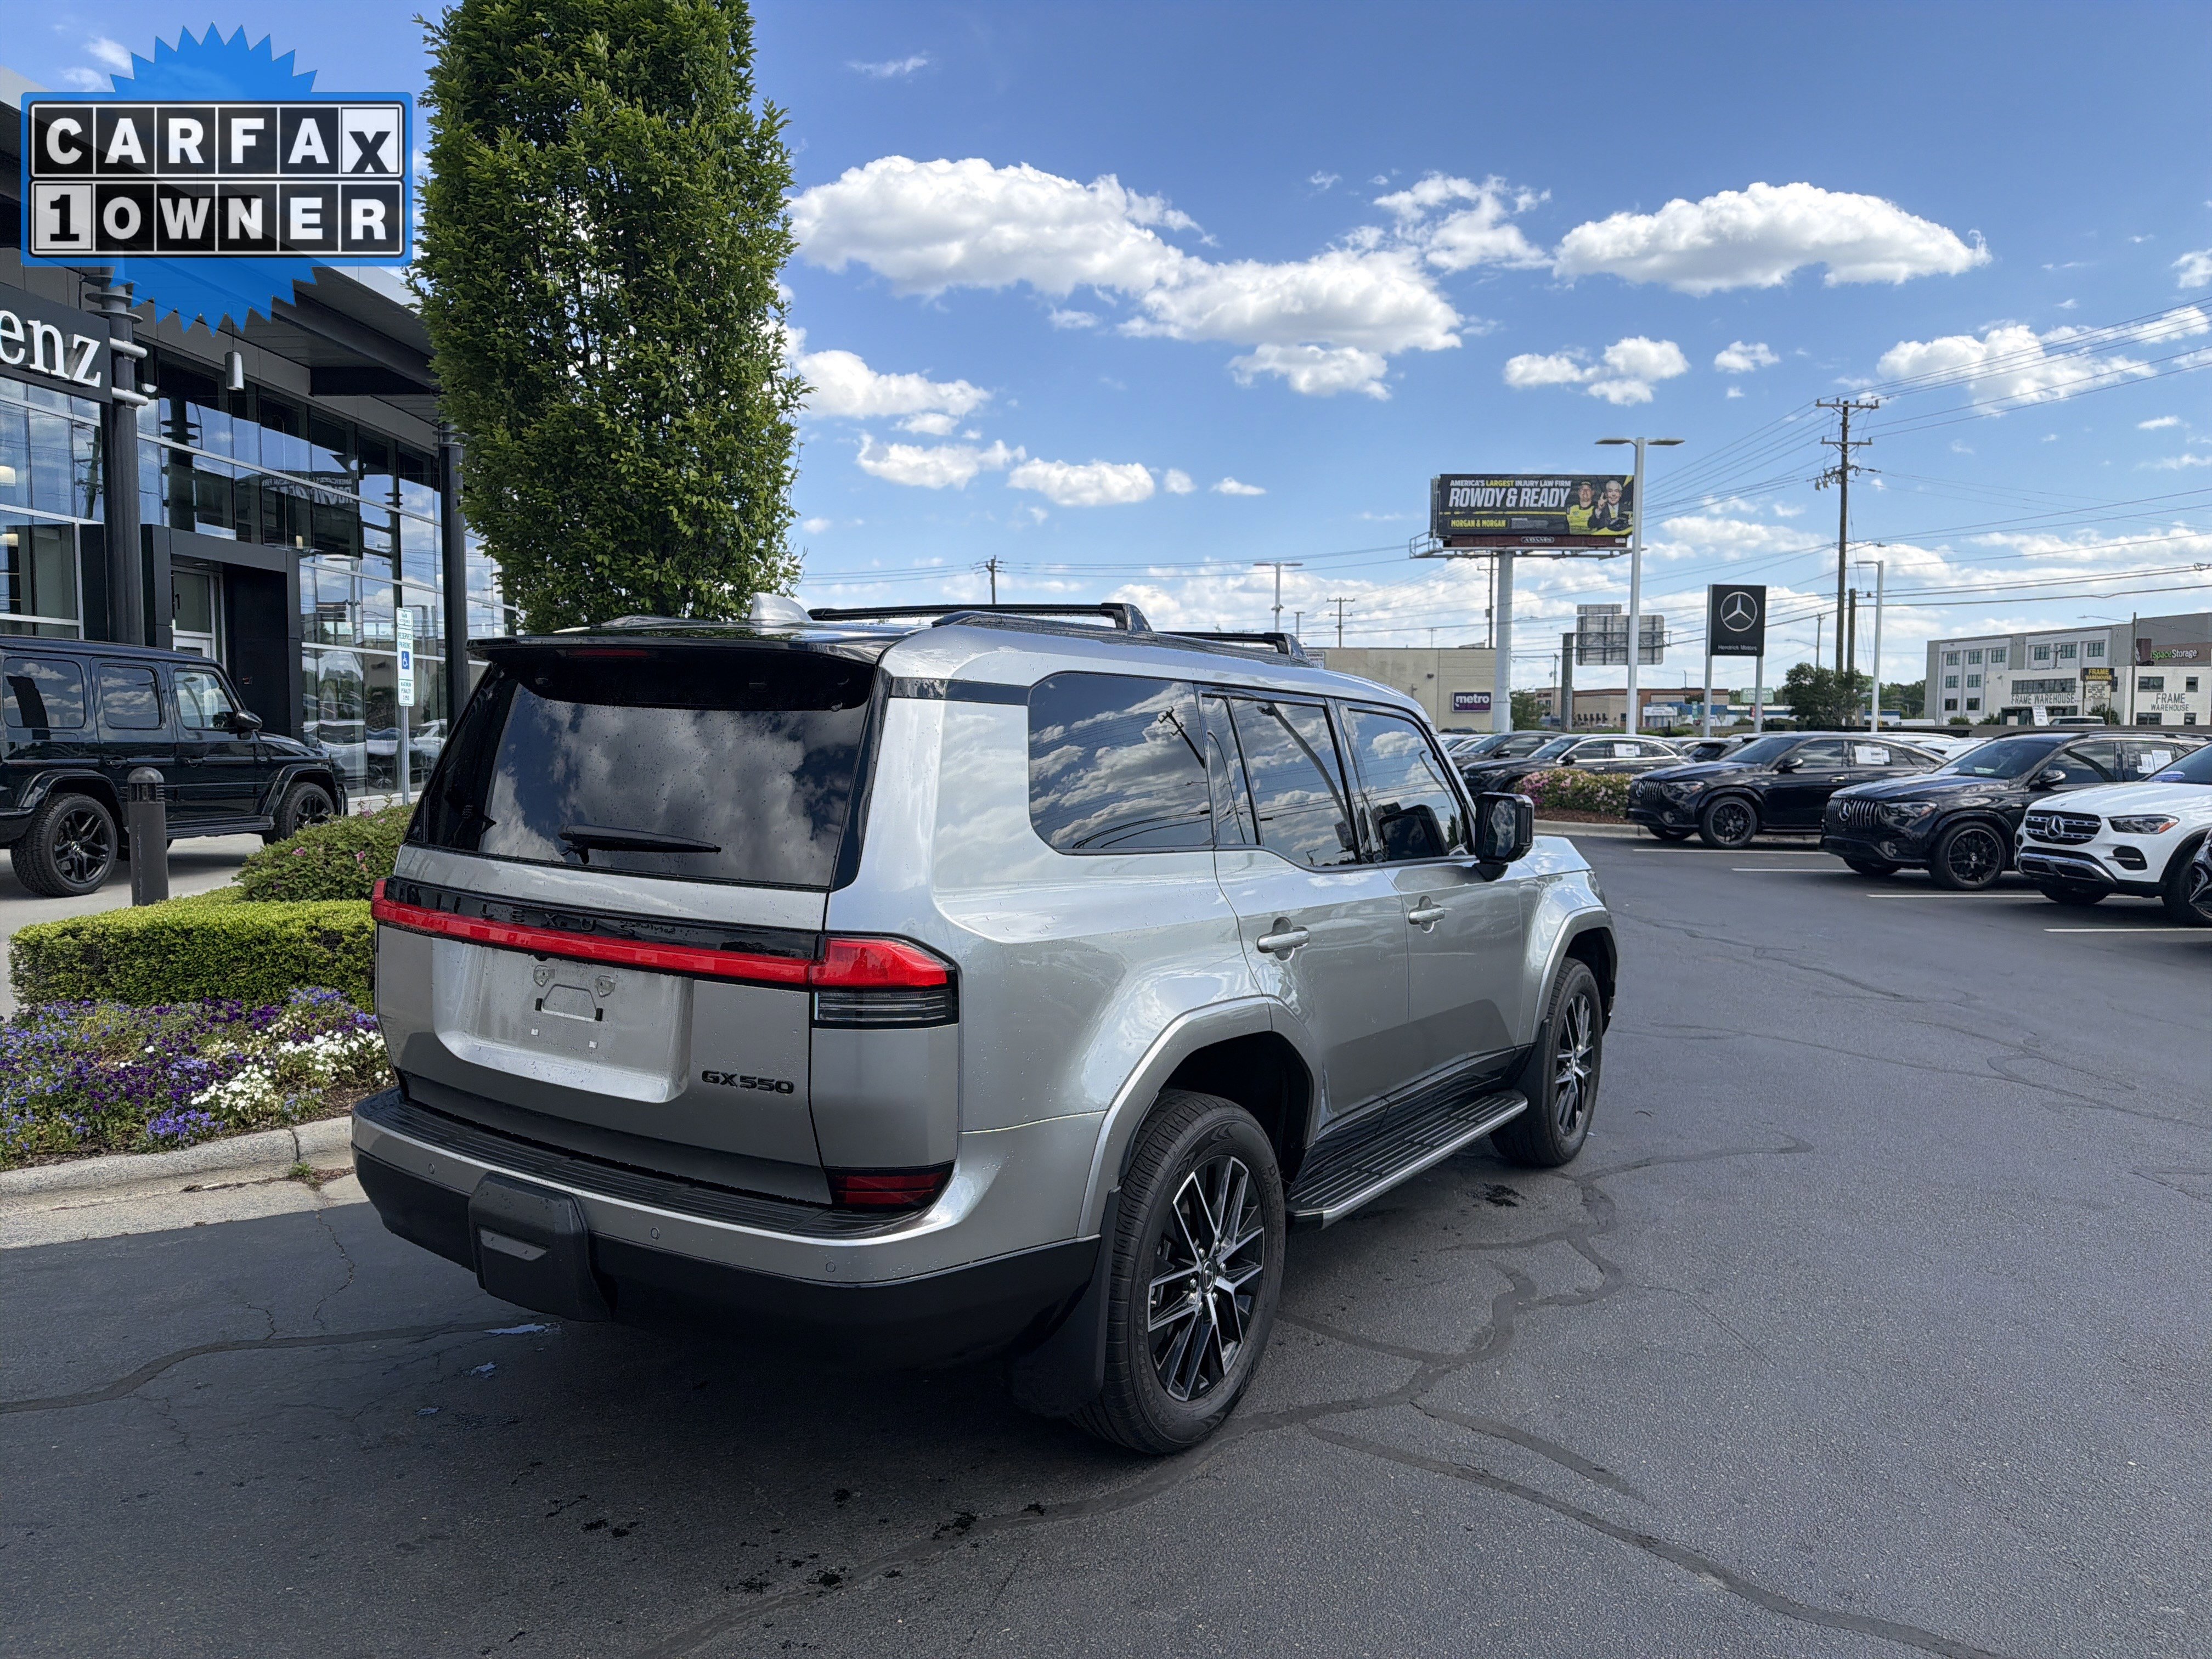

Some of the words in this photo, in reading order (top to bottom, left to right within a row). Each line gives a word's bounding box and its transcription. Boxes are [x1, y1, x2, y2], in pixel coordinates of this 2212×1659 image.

[0, 310, 101, 388] enz
[1448, 488, 1506, 507] ROWDY
[1506, 488, 1517, 507] &
[1519, 488, 1571, 507] READY
[398, 632, 412, 641] RESERVED
[399, 641, 411, 650] PARKING
[1455, 693, 1489, 704] metro
[2011, 693, 2032, 705] FRAME
[2034, 693, 2075, 704] WAREHOUSE
[2156, 692, 2186, 704] FRAME
[2151, 703, 2190, 712] WAREHOUSE
[481, 903, 635, 936] LEXUS
